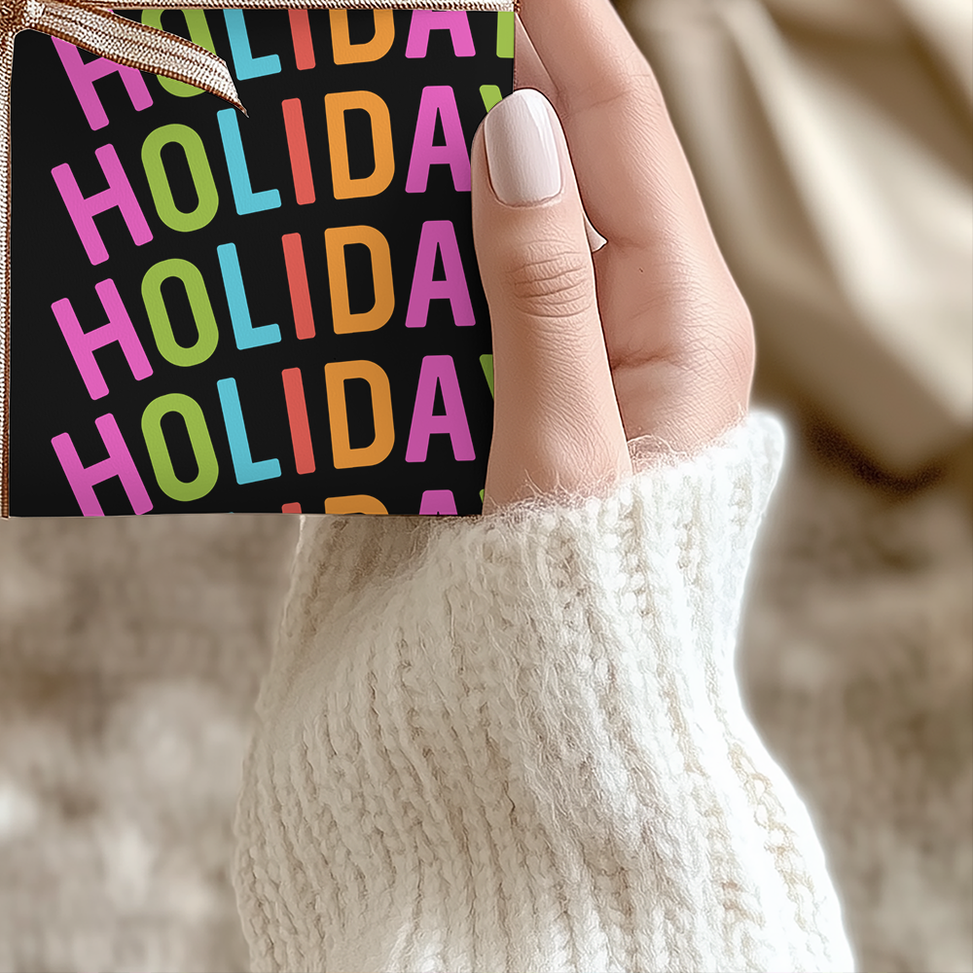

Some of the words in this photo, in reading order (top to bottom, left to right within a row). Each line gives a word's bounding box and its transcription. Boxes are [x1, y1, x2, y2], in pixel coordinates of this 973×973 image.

[51, 85, 502, 265] HOLIDA
[51, 220, 475, 400] HOLIDA
[51, 355, 494, 517] HOLIDA
